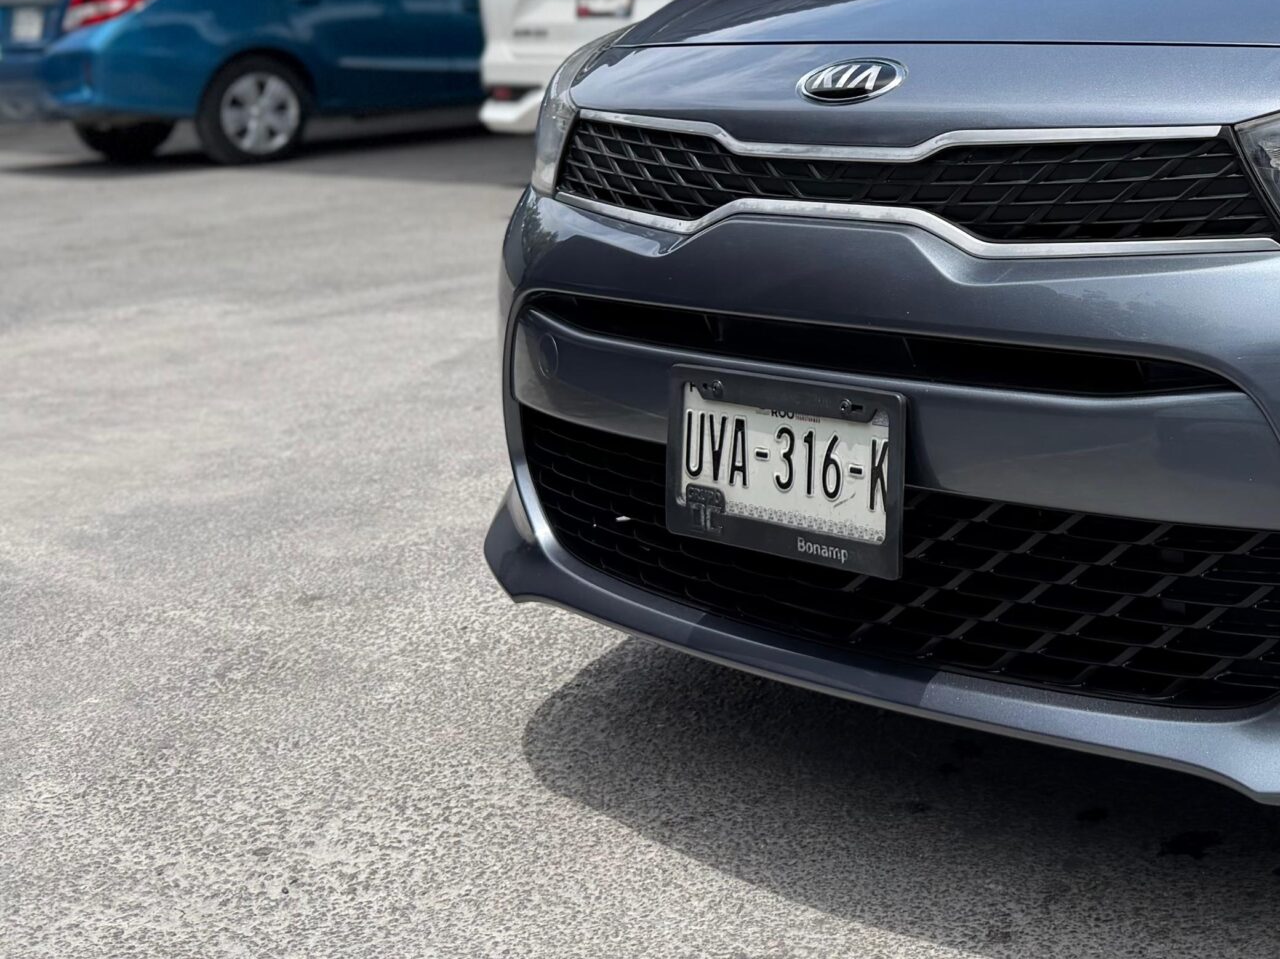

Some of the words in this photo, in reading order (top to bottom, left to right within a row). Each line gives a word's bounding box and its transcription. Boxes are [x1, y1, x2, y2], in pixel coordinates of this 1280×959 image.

[811, 64, 882, 91] KIA
[686, 410, 888, 513] UVA-316-K
[797, 536, 848, 564] Bonamp
